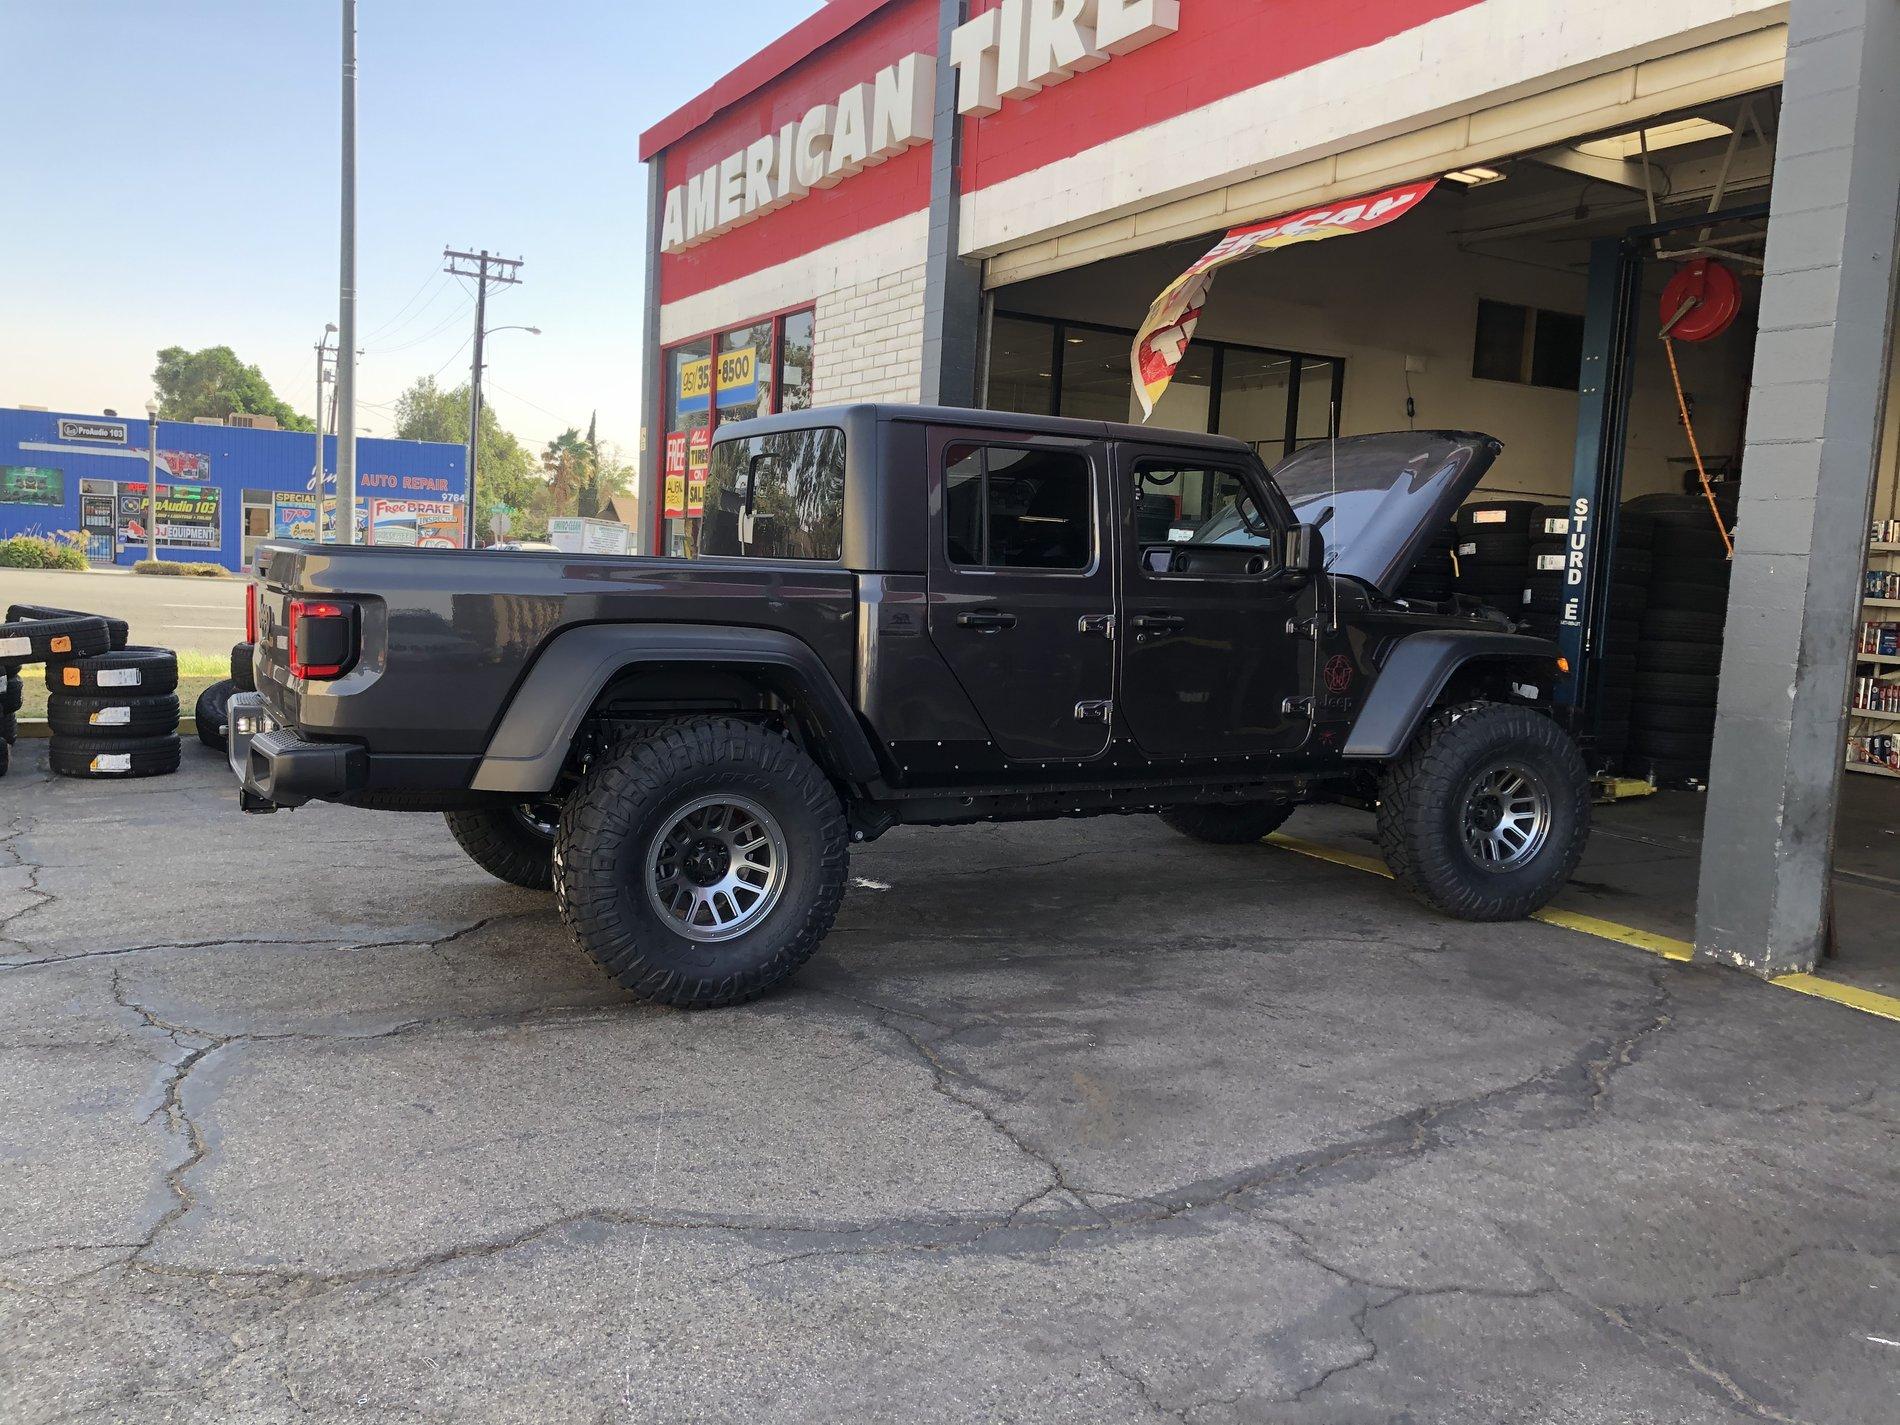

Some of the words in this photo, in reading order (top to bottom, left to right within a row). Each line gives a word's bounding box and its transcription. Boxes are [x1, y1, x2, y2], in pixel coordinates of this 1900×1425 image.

[661, 52, 936, 254] AMERICAN
[79, 427, 108, 437] ProAudio
[110, 429, 123, 437] 103
[691, 430, 707, 443] ALL
[667, 438, 685, 471] FREE
[361, 473, 398, 488] AUTO
[403, 476, 448, 491] REPAIR
[693, 470, 703, 480] ON
[442, 492, 465, 502] 9764
[690, 486, 705, 503] SAL
[140, 497, 193, 512] PoAudio
[195, 502, 216, 514] 103
[408, 502, 450, 515] BRAKE
[167, 526, 213, 540] EQUIPMENT
